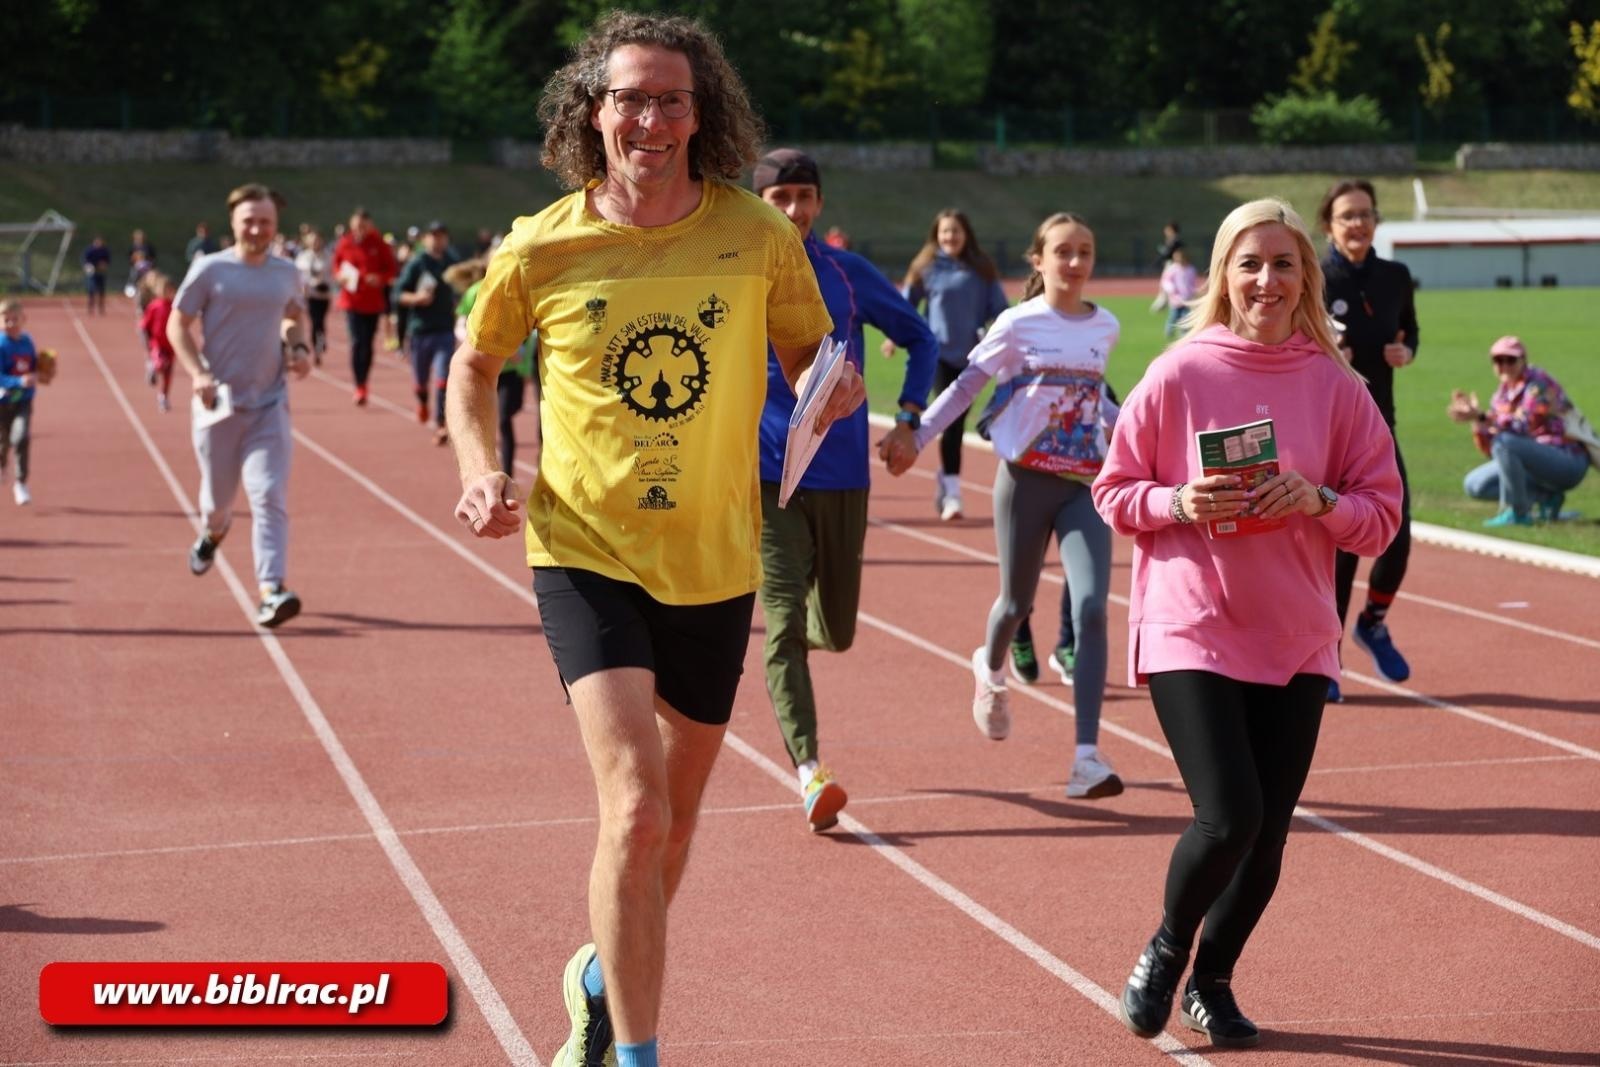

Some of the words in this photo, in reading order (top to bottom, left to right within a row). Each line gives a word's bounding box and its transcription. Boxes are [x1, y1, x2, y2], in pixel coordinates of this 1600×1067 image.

[637, 312, 672, 327] ESTEBAN
[674, 315, 688, 328] DEL
[620, 321, 637, 336] SAN
[690, 323, 711, 345] VALLE
[606, 334, 622, 352] BTT
[601, 354, 614, 383] MARCHA
